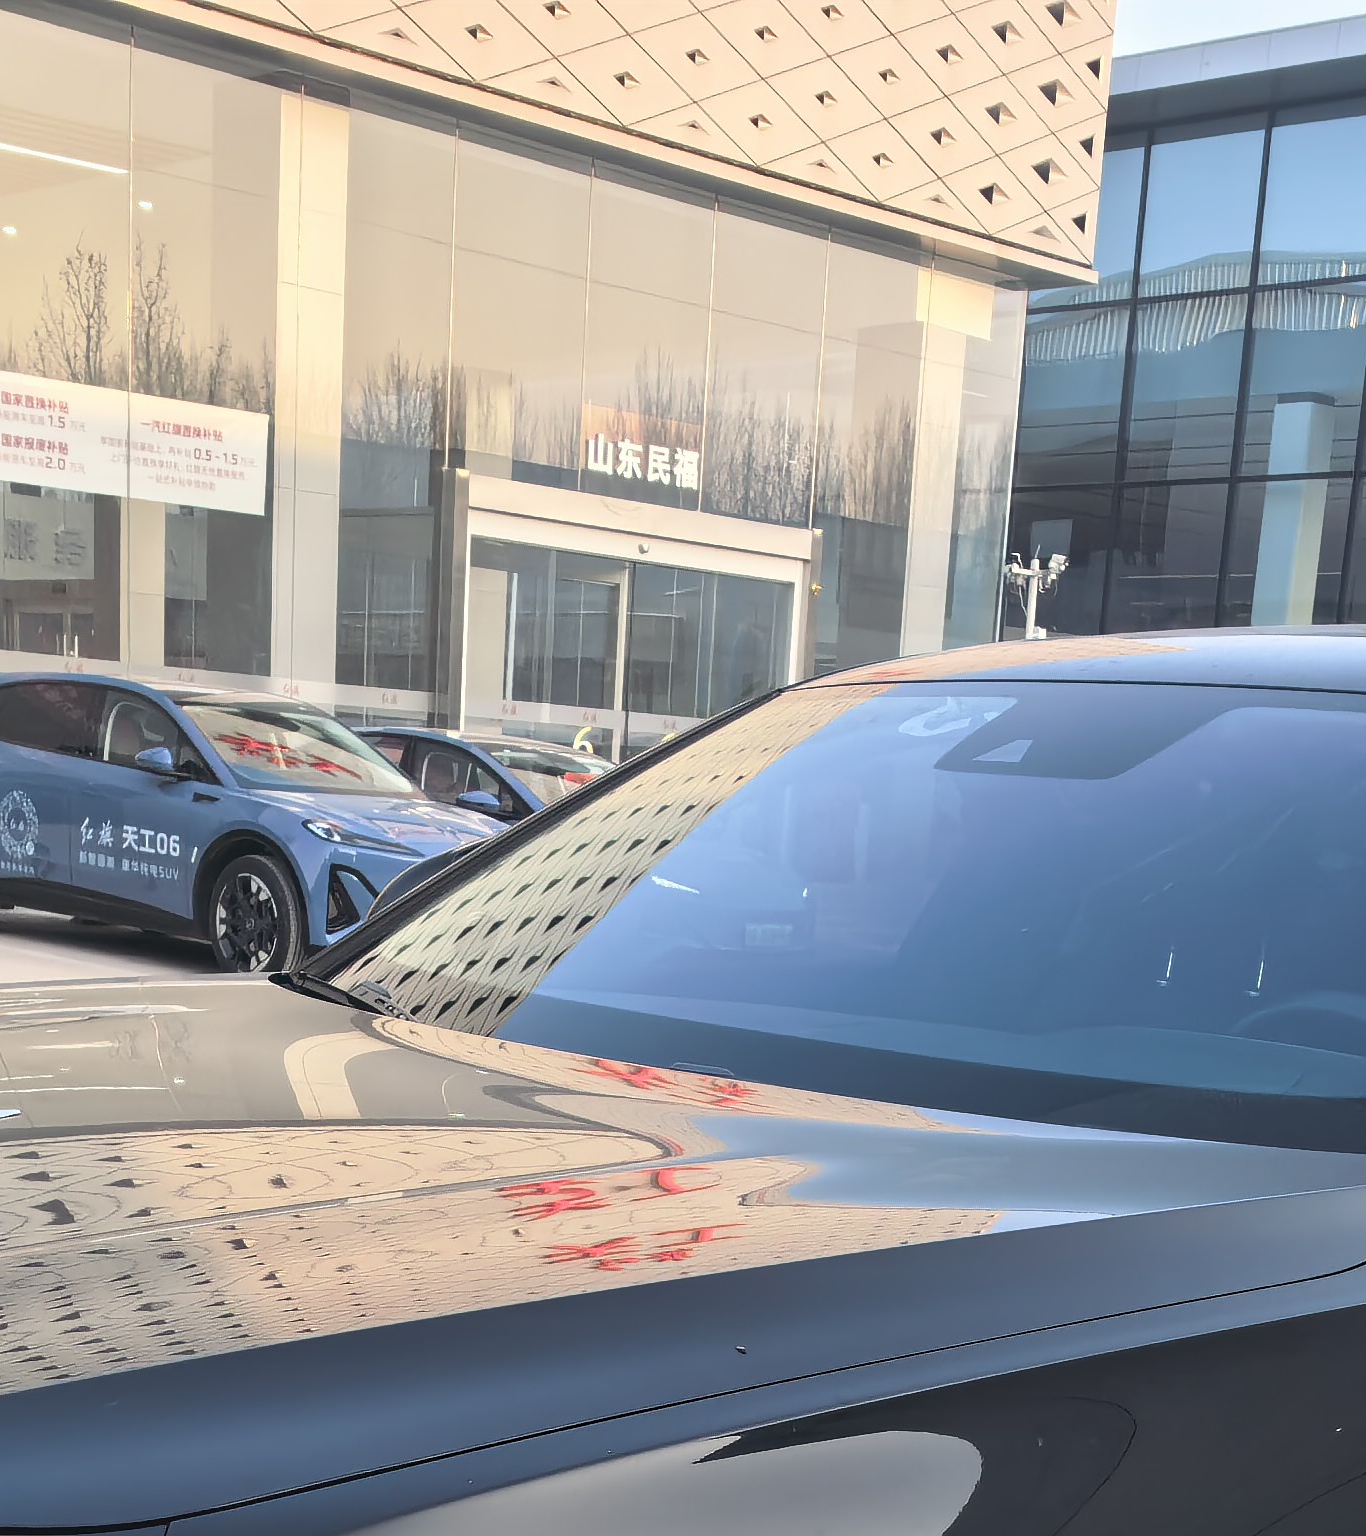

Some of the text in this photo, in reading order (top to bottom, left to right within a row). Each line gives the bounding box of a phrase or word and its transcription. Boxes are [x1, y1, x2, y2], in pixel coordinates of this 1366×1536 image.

[586, 432, 700, 490] 山东民福
[122, 824, 180, 857] 天工06
